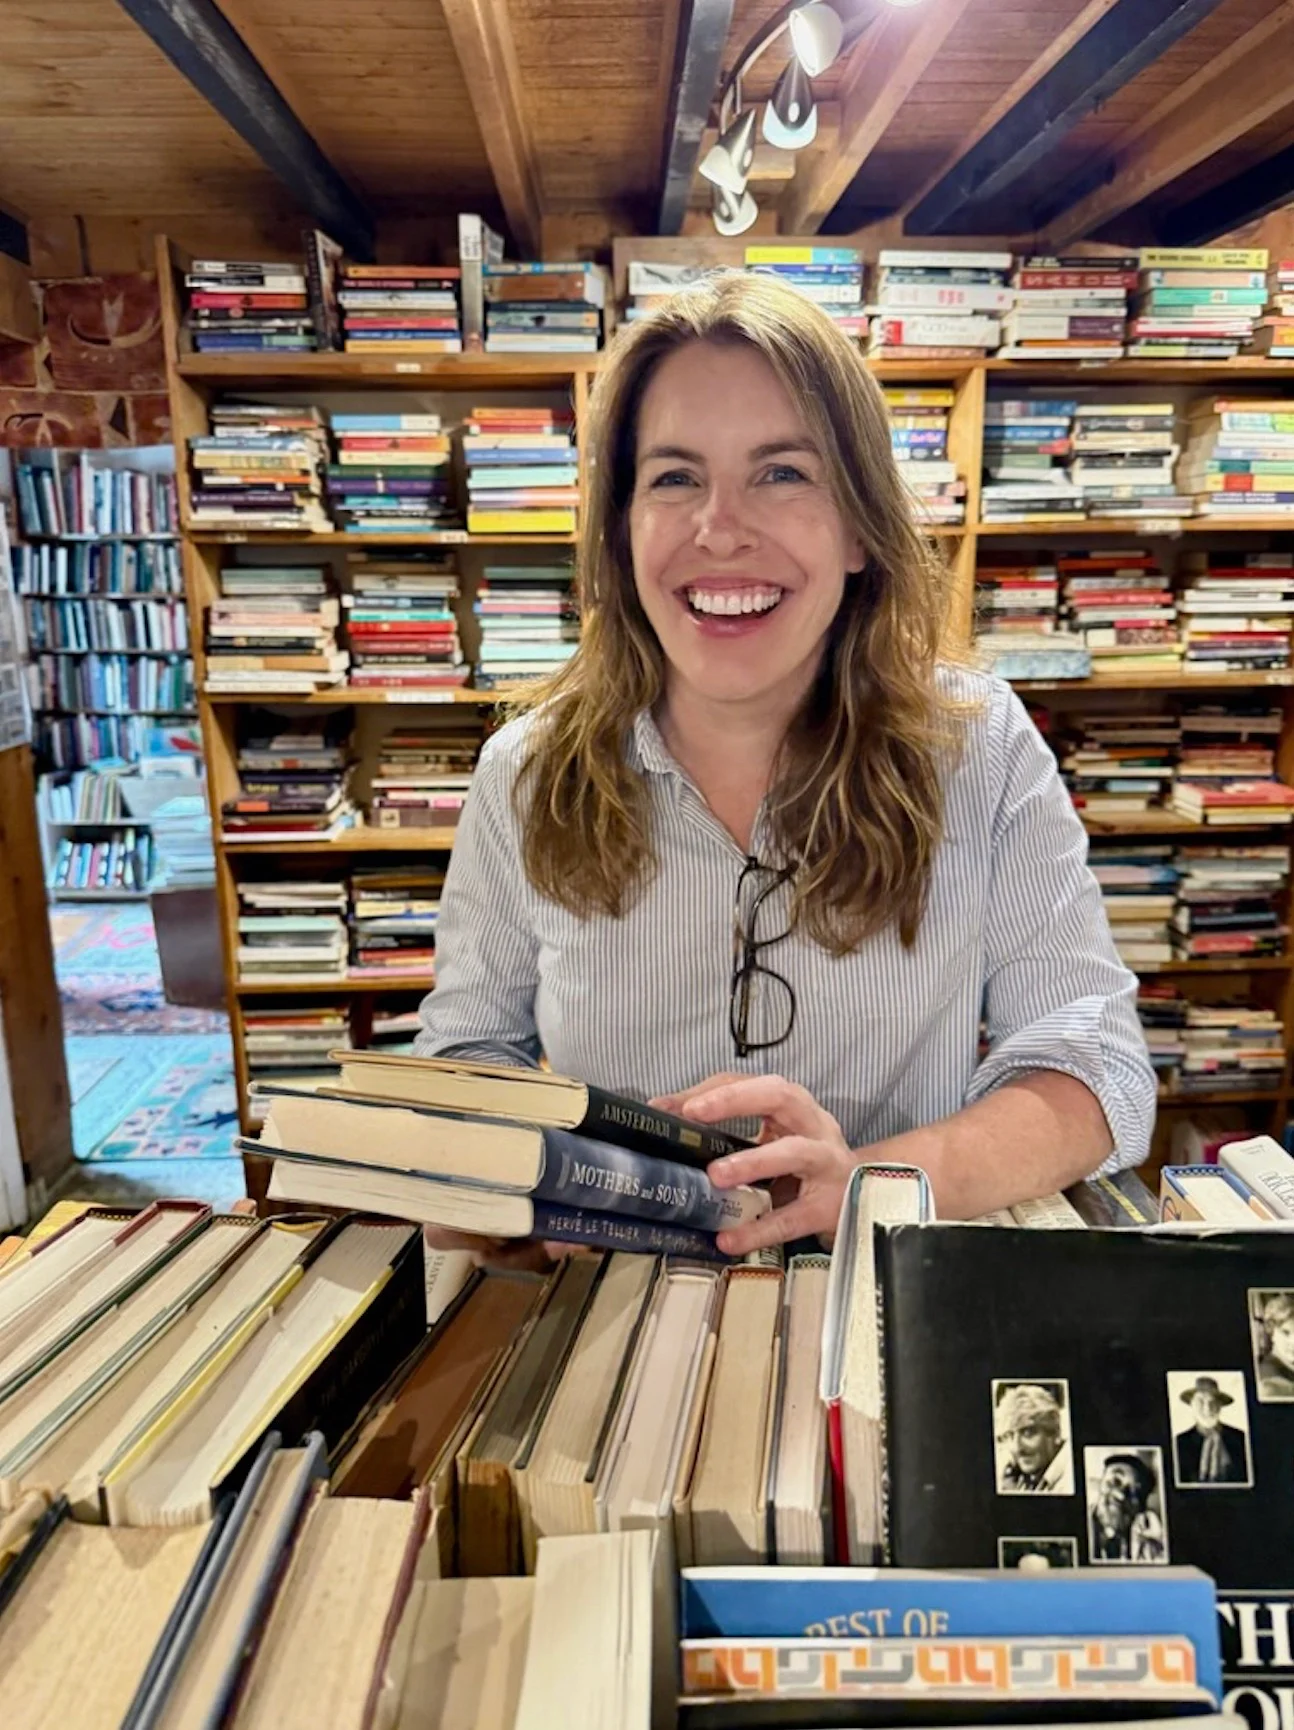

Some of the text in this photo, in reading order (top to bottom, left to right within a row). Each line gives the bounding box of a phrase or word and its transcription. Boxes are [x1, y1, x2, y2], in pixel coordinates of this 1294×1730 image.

[601, 1103, 671, 1139] AMSTERDAM
[571, 1162, 641, 1197] MOTHERS
[641, 1188, 654, 1200] and
[655, 1184, 688, 1207] SONS
[548, 1211, 583, 1234] HERVÉ
[585, 1218, 598, 1233] LE
[602, 1220, 640, 1242] TELLIER
